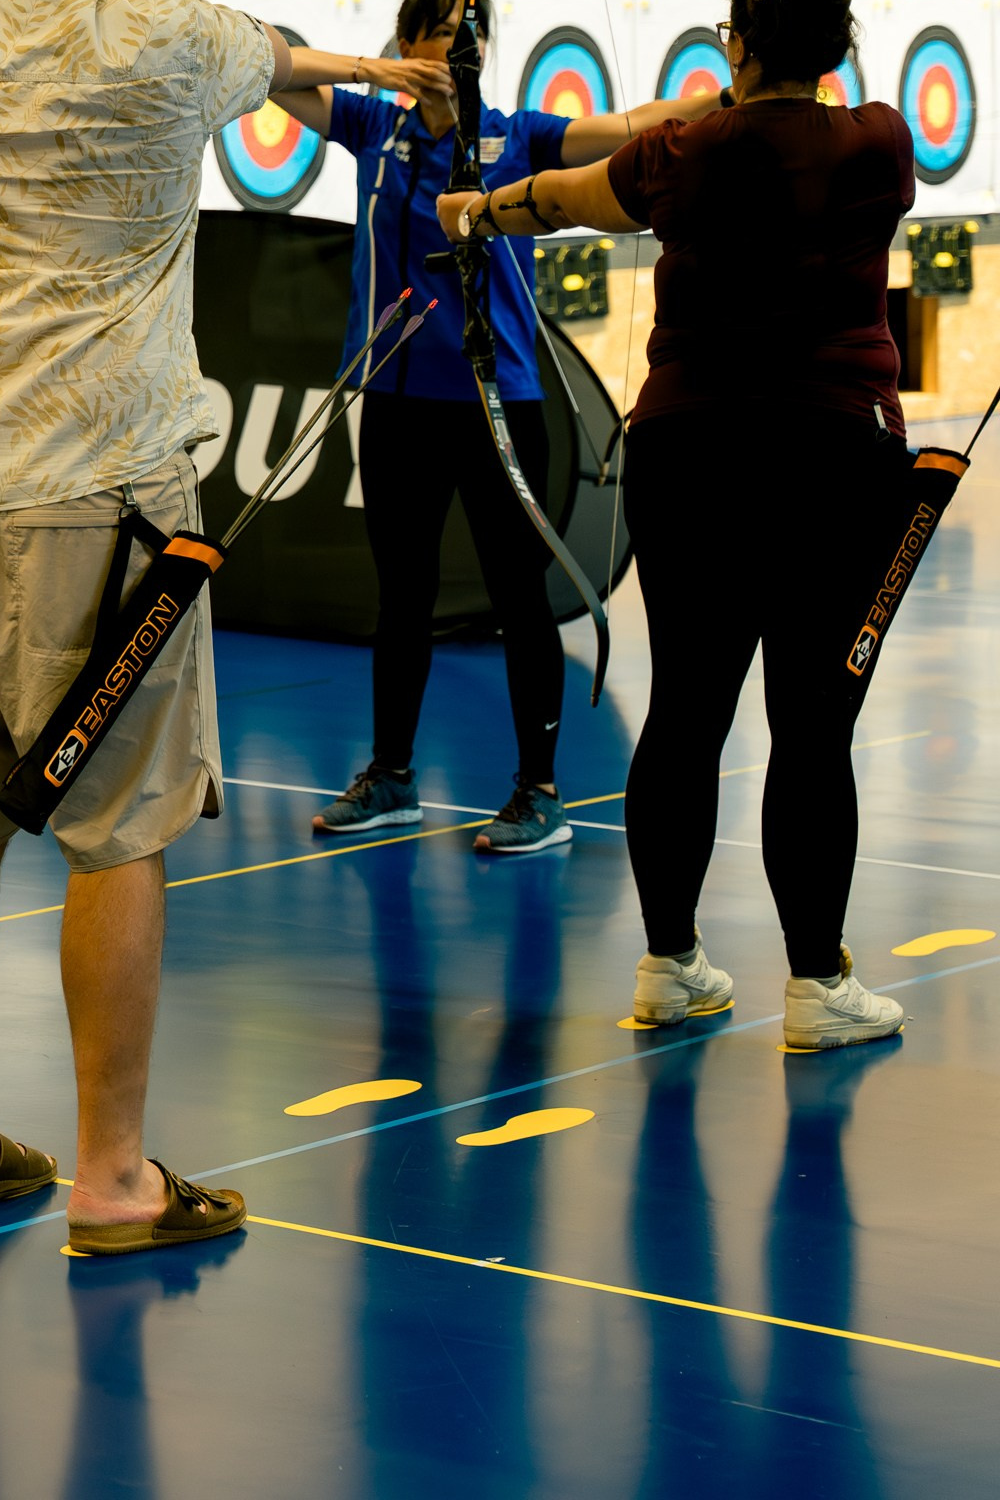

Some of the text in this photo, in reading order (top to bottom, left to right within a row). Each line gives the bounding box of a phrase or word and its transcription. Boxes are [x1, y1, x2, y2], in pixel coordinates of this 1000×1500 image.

[508, 466, 536, 504] HIT
[865, 502, 937, 634] EASTON
[74, 593, 179, 742] EASTON
